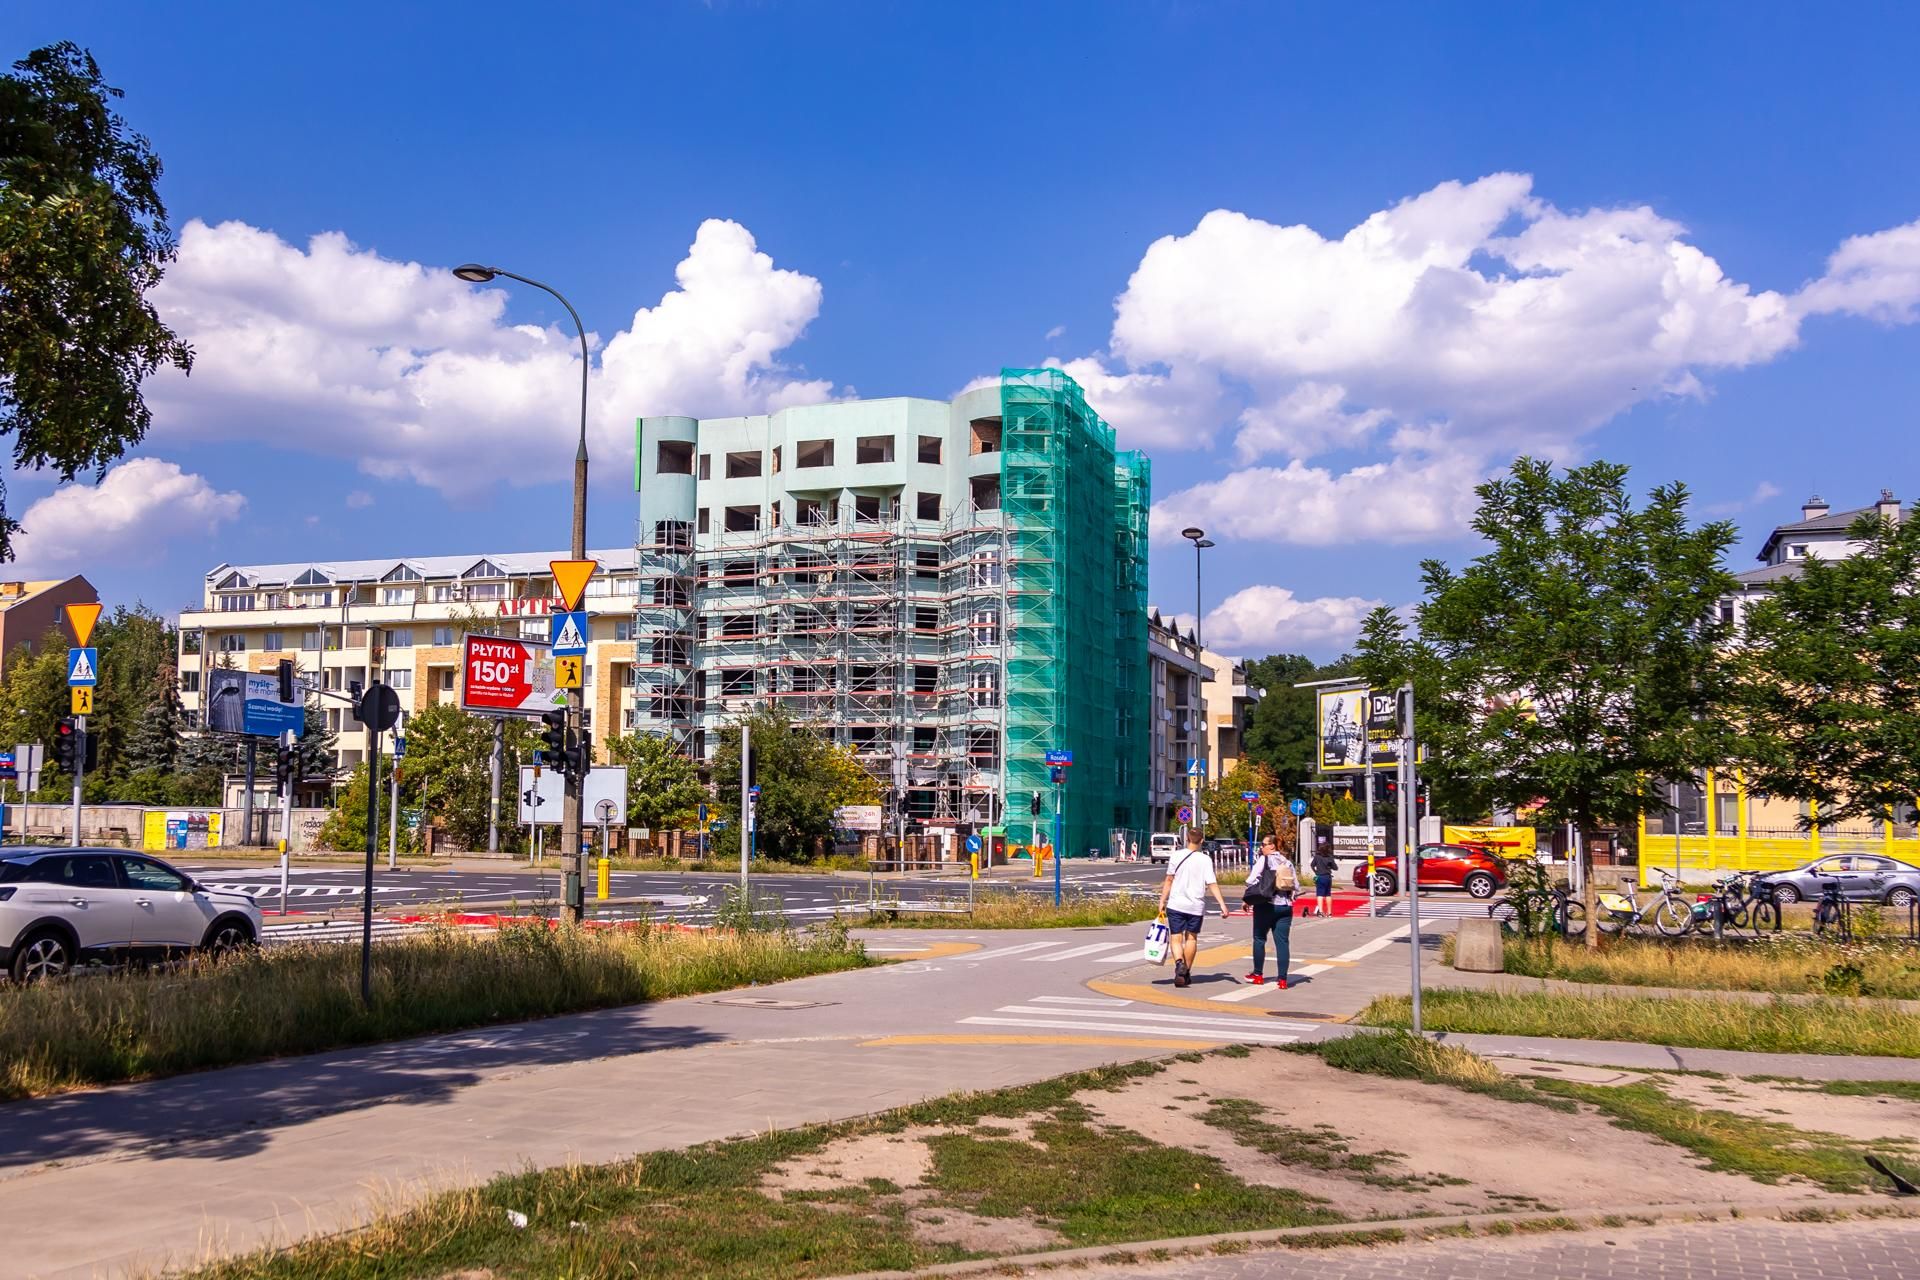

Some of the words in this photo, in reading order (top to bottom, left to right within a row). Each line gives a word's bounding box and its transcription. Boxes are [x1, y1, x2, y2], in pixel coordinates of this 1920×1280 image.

[499, 597, 568, 615] APTEK
[471, 643, 515, 659] PŁYTKI
[471, 660, 510, 684] 150
[510, 664, 519, 674] zł
